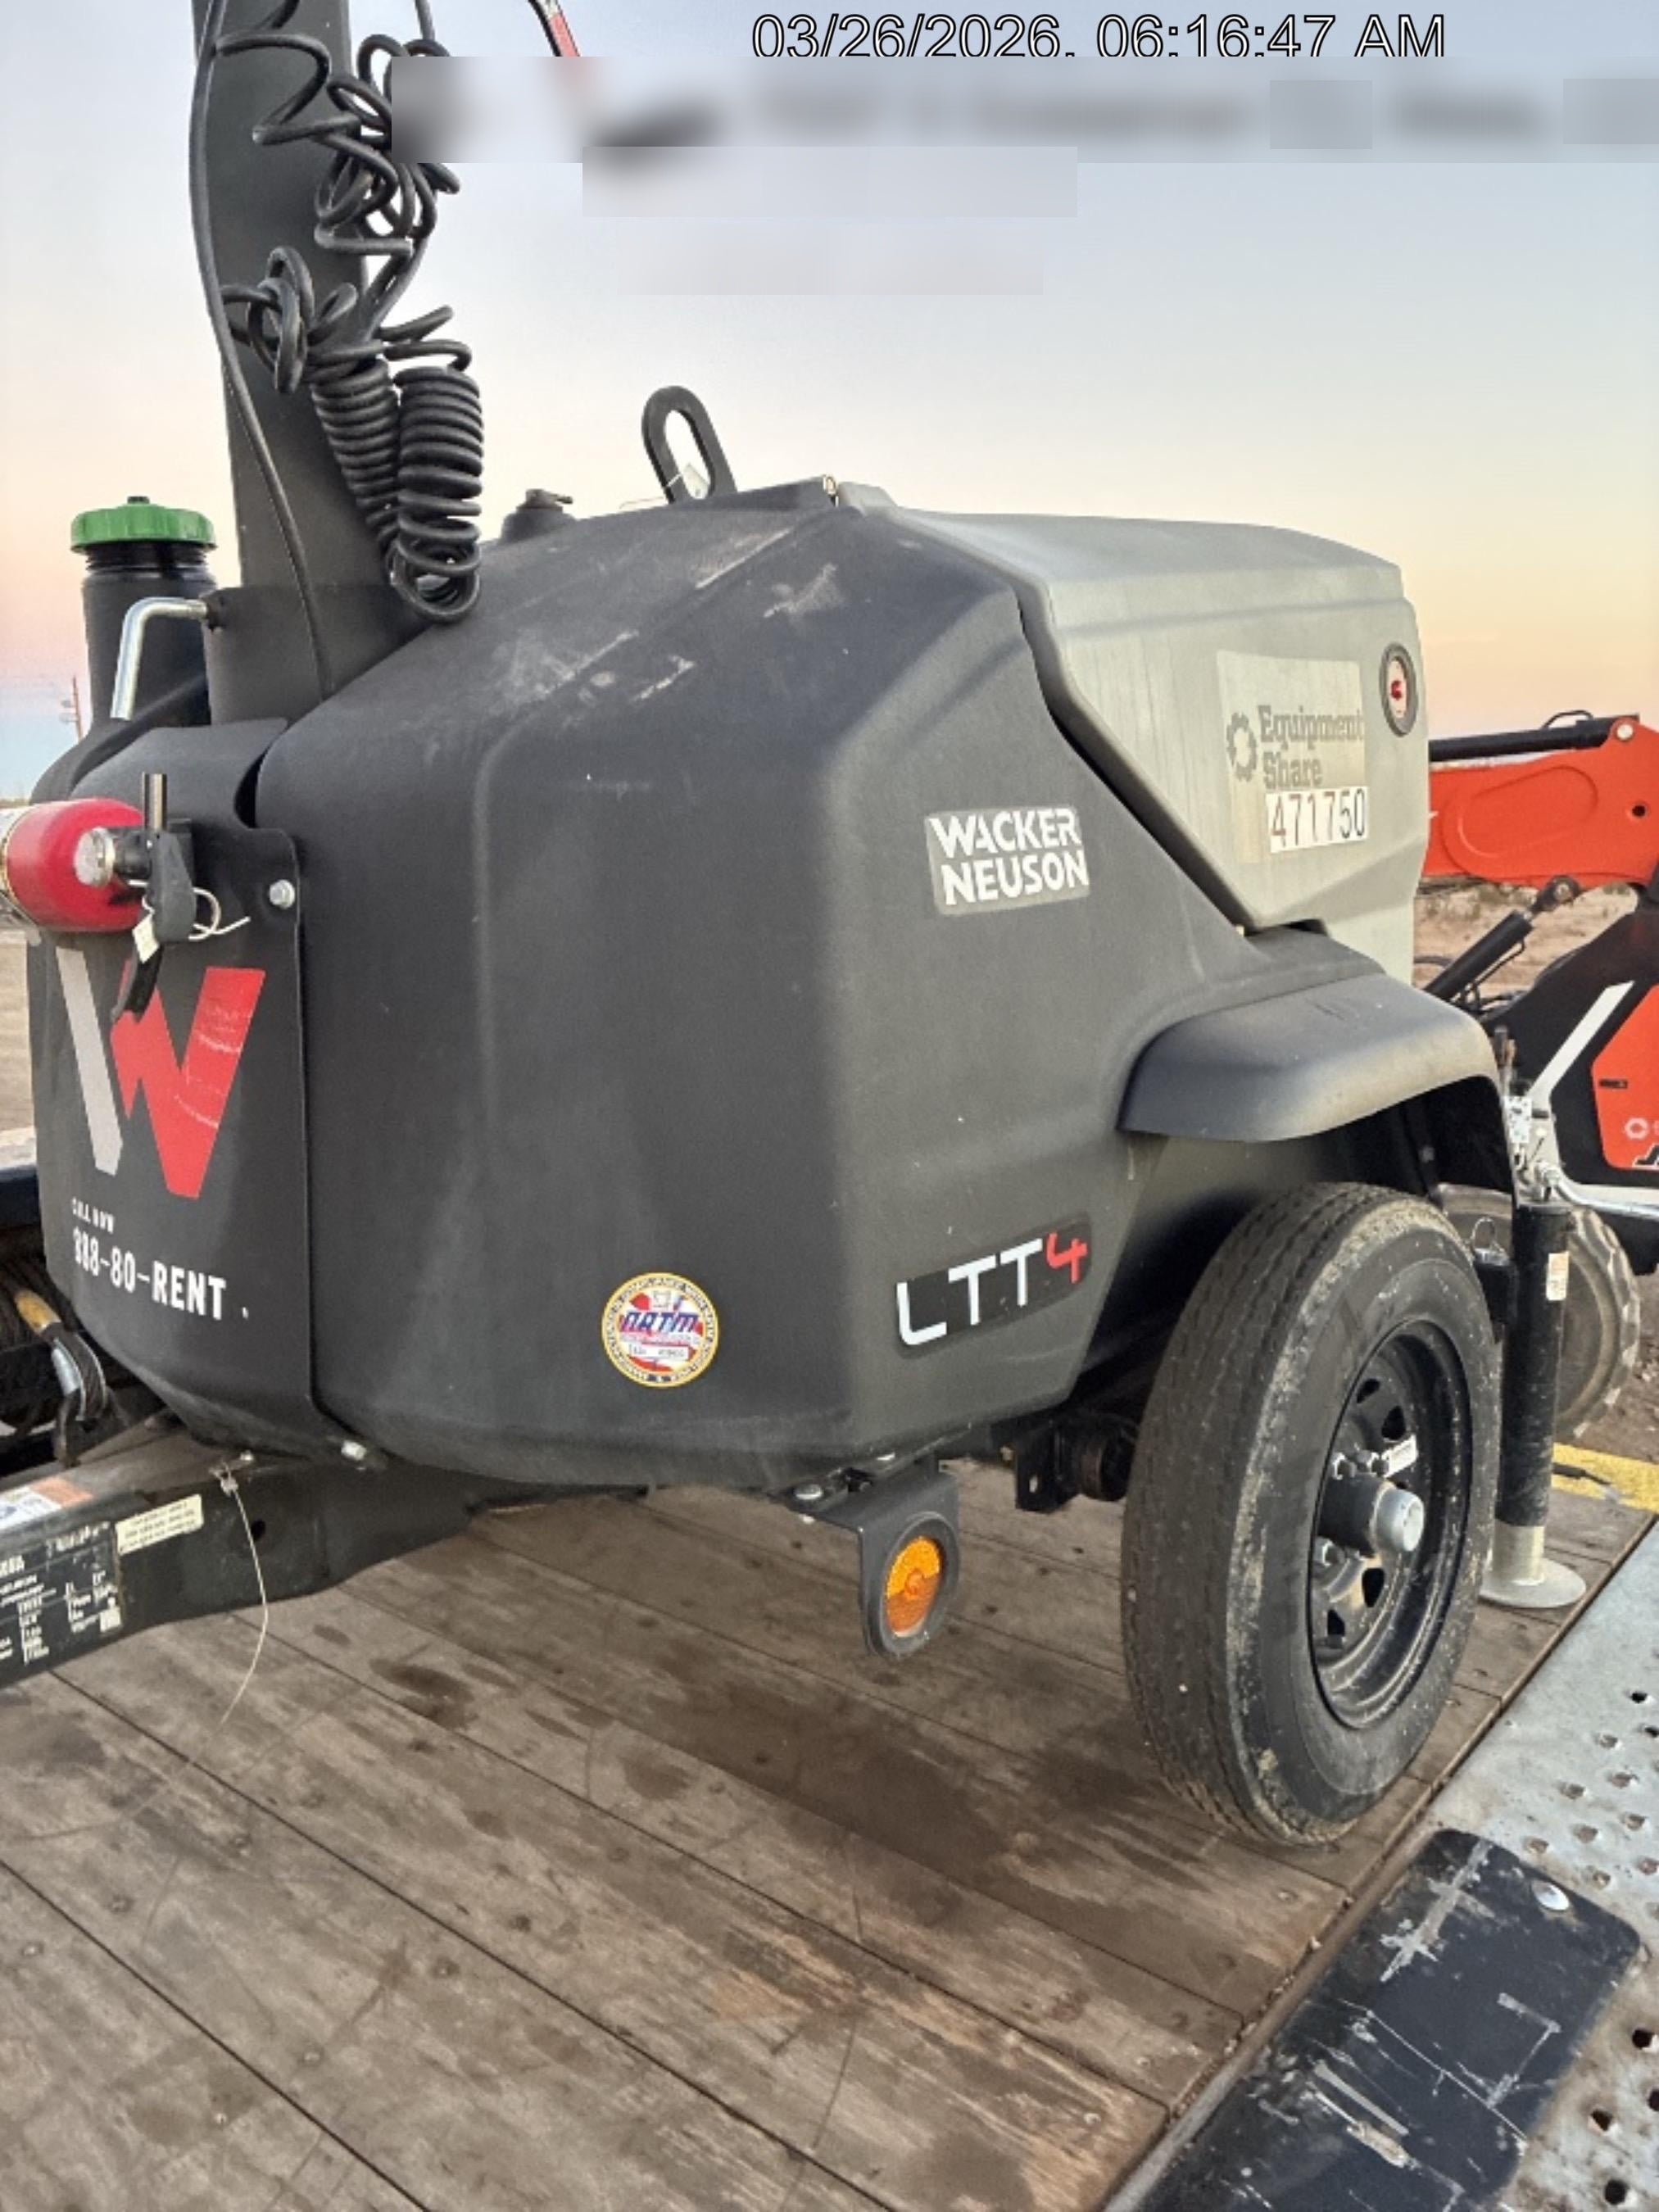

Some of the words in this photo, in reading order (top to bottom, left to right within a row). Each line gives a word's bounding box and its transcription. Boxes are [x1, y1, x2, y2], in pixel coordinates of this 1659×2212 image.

[1258, 704, 1364, 750] Equipment
[1262, 750, 1324, 789] Share
[928, 807, 1082, 859] WACKER
[1271, 787, 1367, 848] 471750
[941, 849, 1090, 905] NEUSON
[896, 1231, 1089, 1346] LTT4
